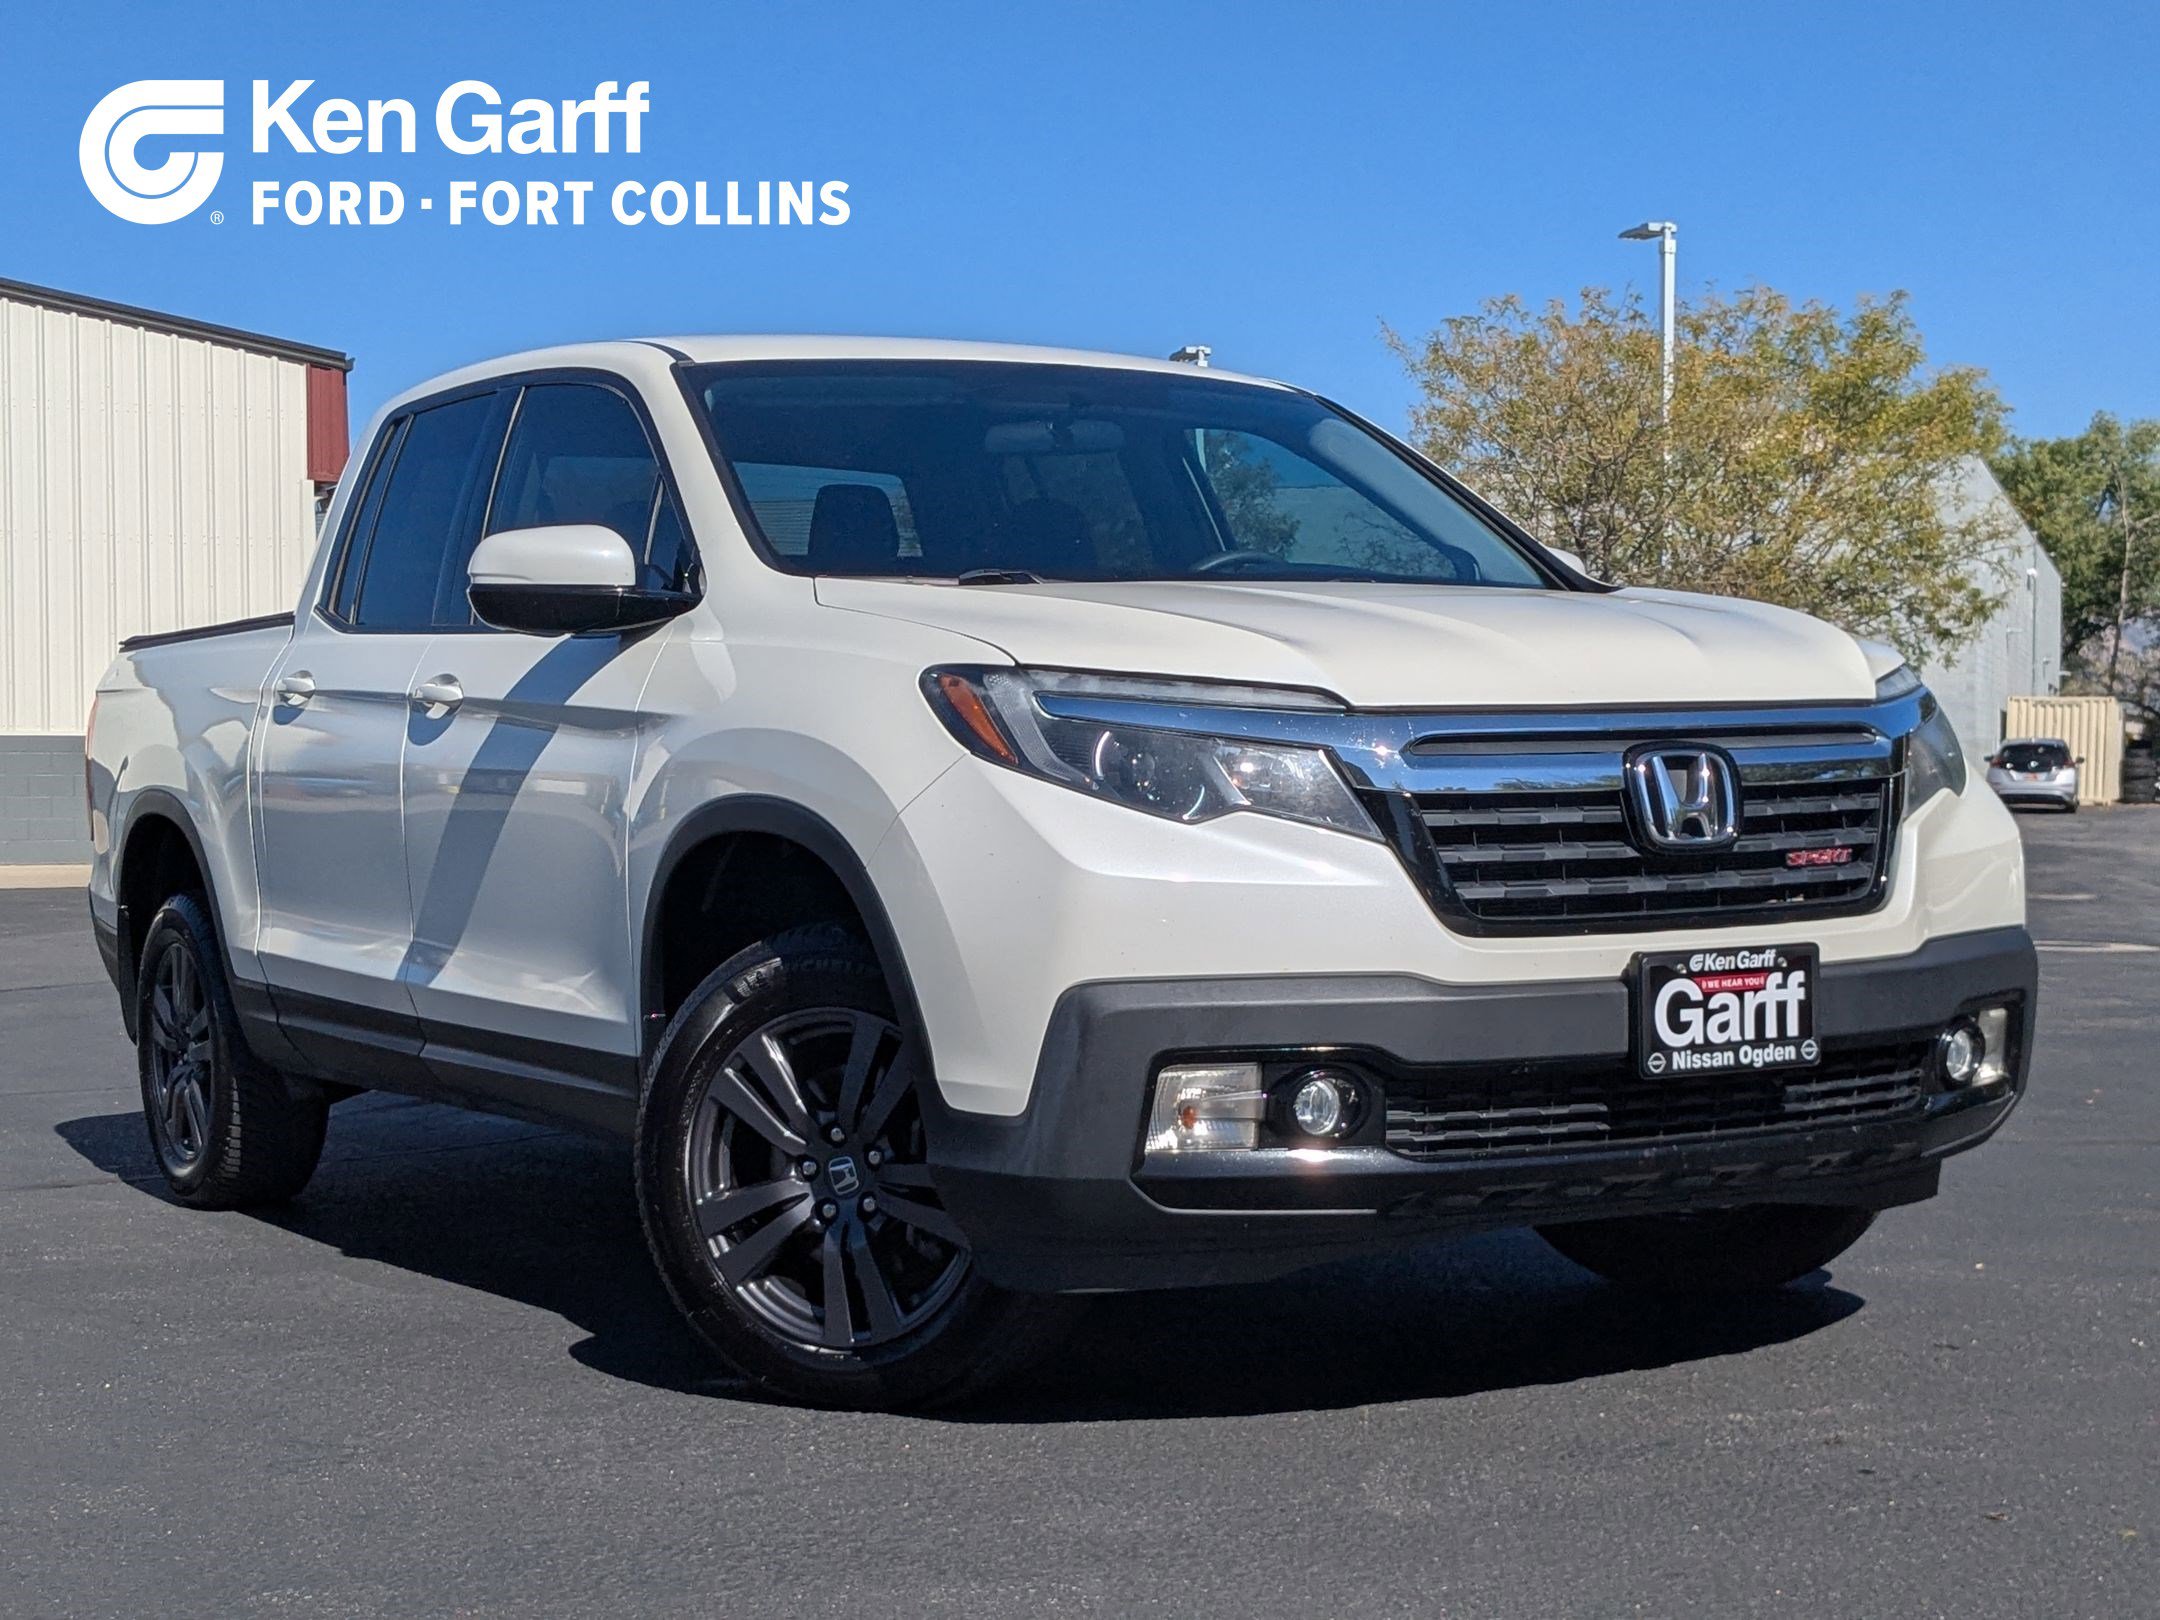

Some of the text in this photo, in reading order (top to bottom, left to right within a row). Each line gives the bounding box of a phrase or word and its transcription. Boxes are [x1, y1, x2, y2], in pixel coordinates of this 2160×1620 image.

[1703, 952, 1735, 971] Ken
[1736, 949, 1776, 969] Garff
[1707, 977, 1760, 989] WE HEAR YOU
[1654, 970, 1806, 1048] Garff
[1672, 1044, 1796, 1071] Nissan Ogden
